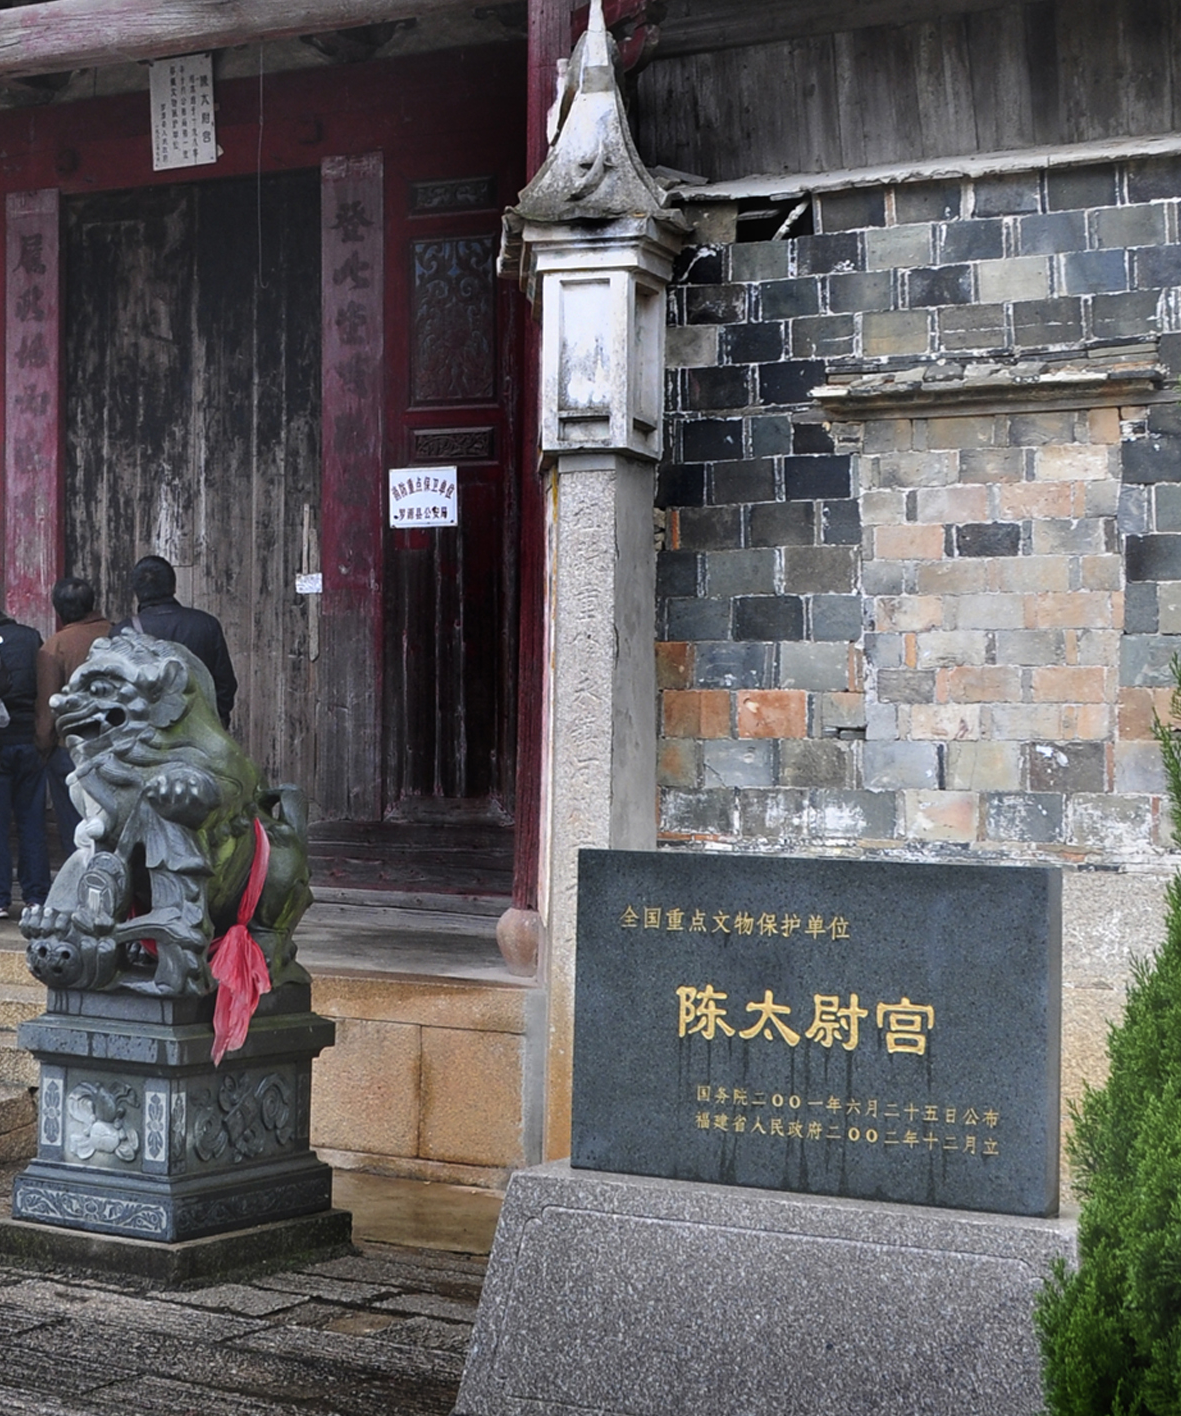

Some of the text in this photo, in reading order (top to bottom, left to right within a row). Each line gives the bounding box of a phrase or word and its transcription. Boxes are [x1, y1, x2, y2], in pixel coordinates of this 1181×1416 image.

[619, 905, 850, 940] 全国重点文物保护单位
[675, 984, 935, 1057] 陈太尉宫
